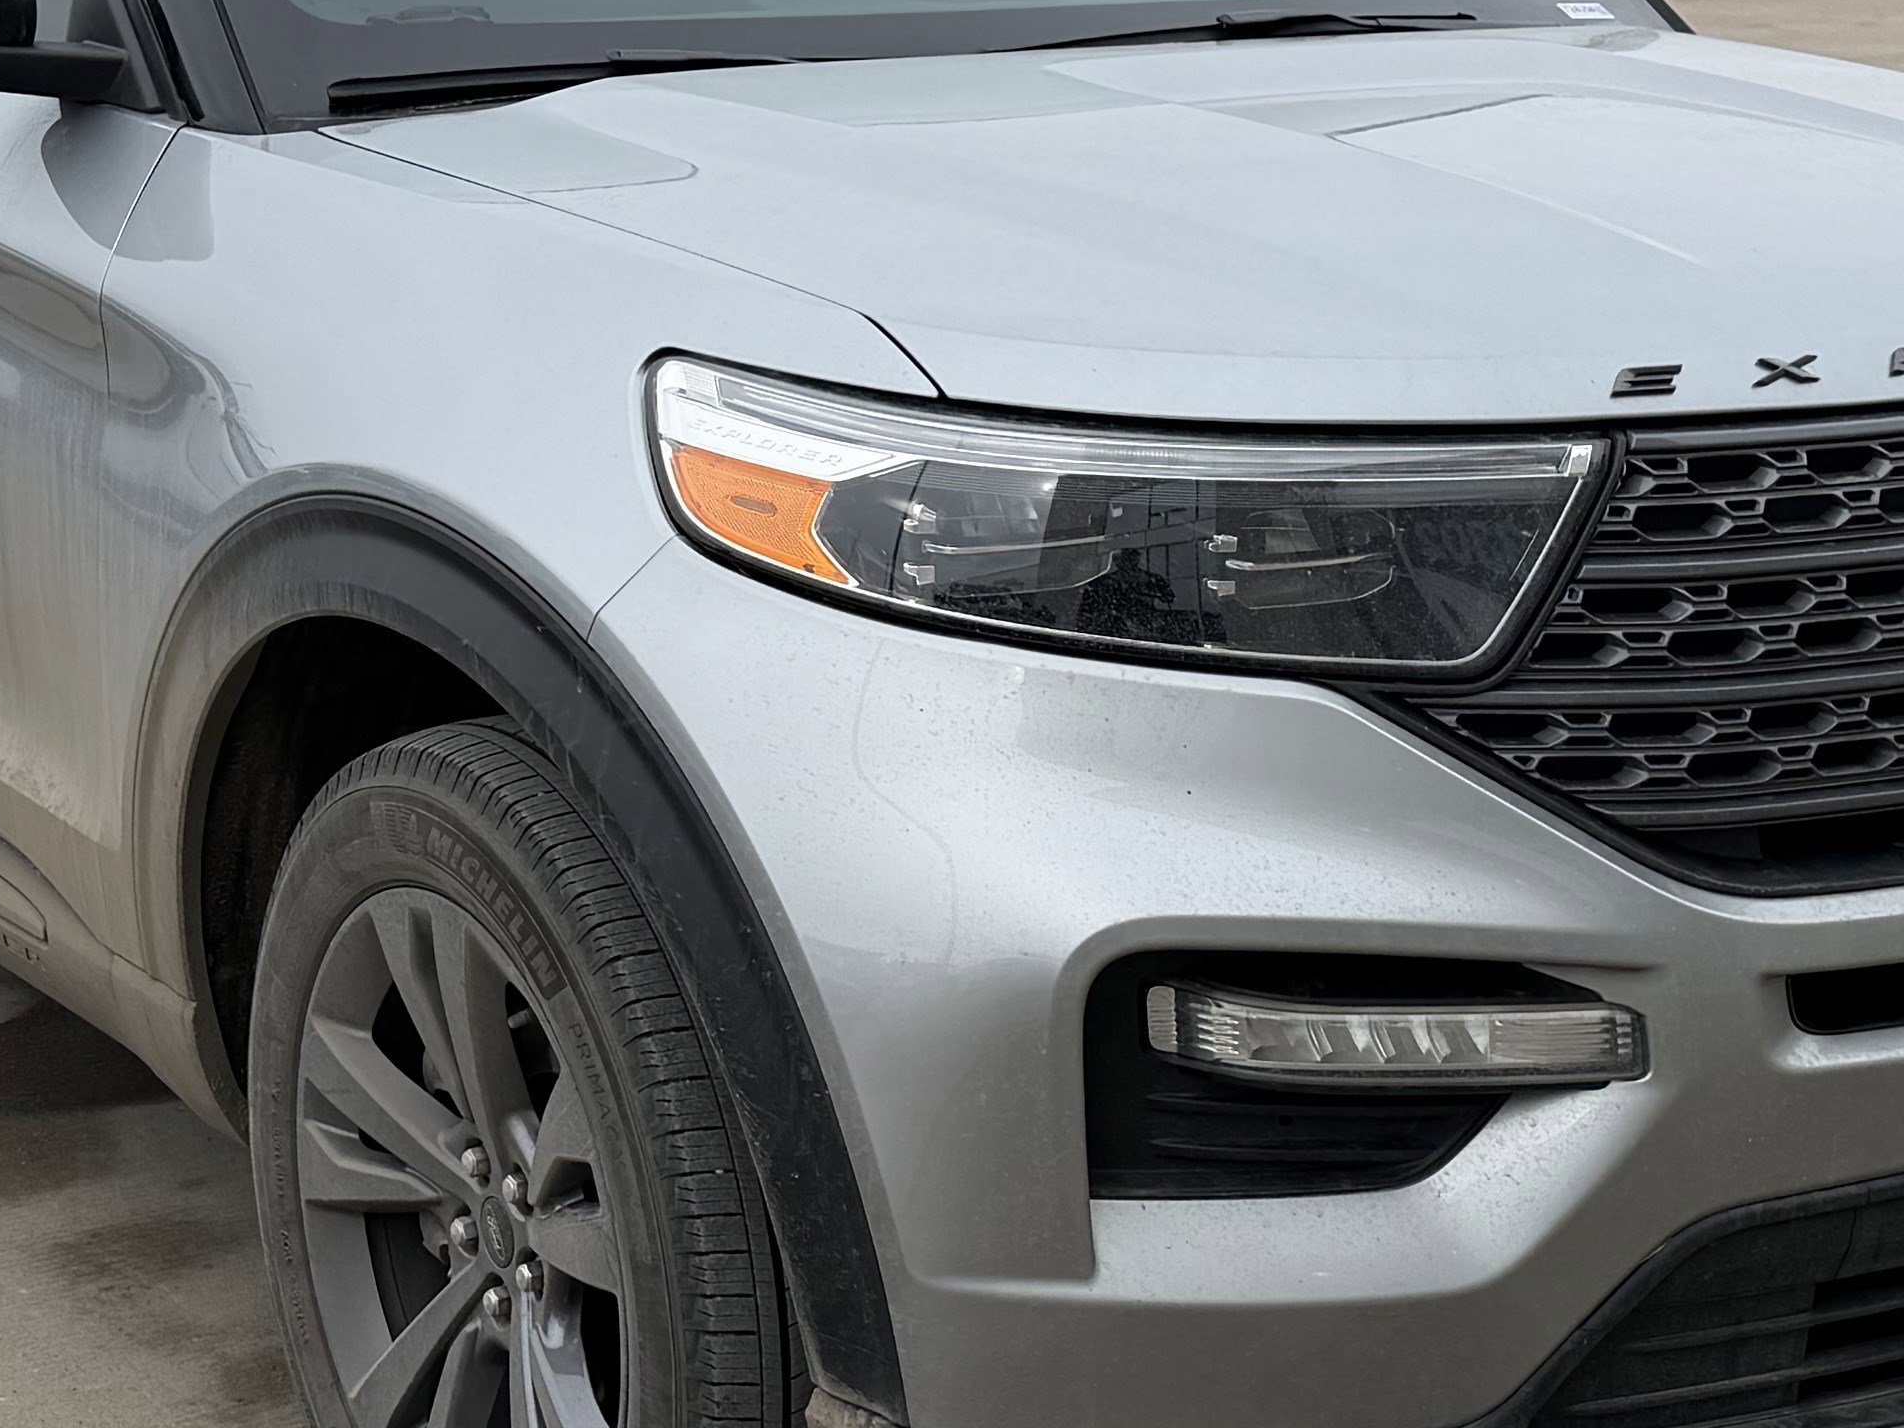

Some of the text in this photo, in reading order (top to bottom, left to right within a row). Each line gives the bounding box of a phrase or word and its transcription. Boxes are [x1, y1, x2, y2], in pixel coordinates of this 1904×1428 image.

[688, 418, 844, 467] EXPLORER
[427, 826, 558, 988] MICHELIN
[568, 1021, 627, 1172] PRIMACY
